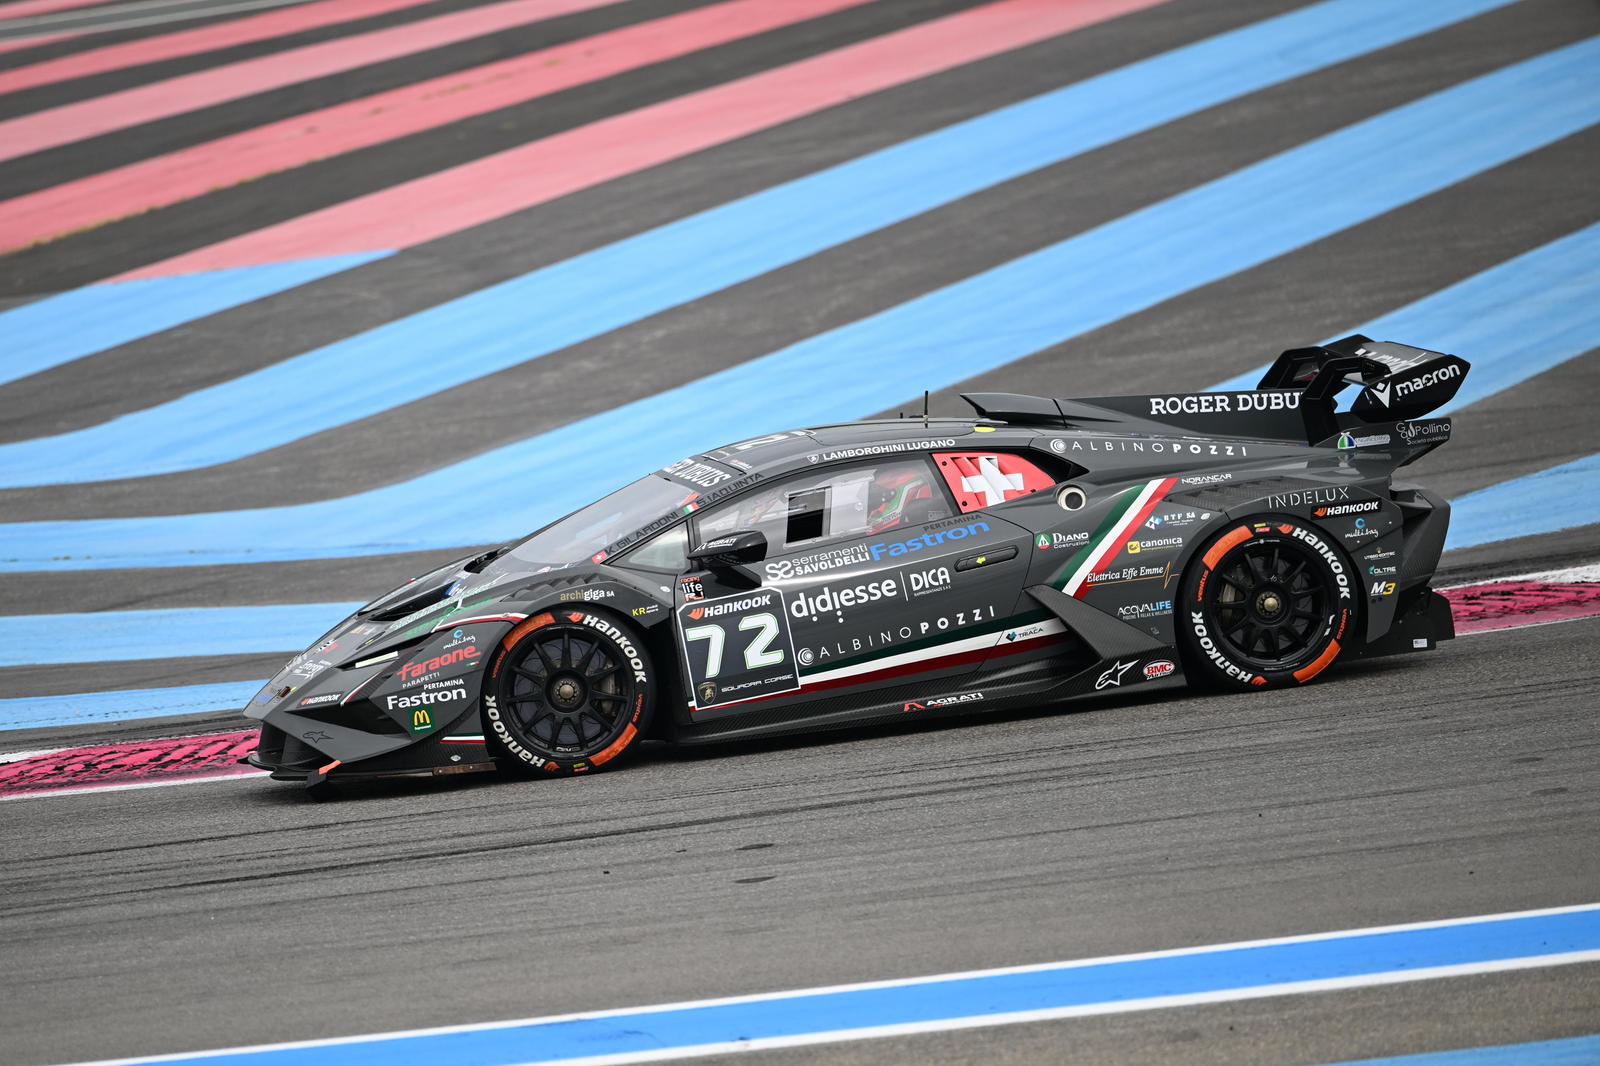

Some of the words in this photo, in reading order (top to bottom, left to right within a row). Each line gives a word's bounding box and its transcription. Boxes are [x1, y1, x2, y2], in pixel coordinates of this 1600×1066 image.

[1395, 364, 1460, 397] macron
[1150, 394, 1231, 415] ROGER
[1237, 391, 1303, 411] DUBU
[822, 443, 905, 461] LAMBORGHINI
[907, 439, 956, 450] LUGANO
[1181, 473, 1232, 484] NORANCAR
[1268, 486, 1349, 508] INDELUX
[922, 513, 983, 532] PERTAMINA
[869, 521, 991, 561] Fastron
[1141, 537, 1183, 548] canonica
[792, 543, 868, 566] serramenti
[795, 552, 870, 576] SAVOLDELLI
[1087, 571, 1120, 583] Elettrica
[1122, 568, 1138, 580] Effe
[1140, 566, 1164, 576] Emme
[560, 589, 605, 601] archigiga
[682, 582, 703, 593] life
[790, 579, 897, 623] didiesse
[909, 566, 951, 591] DICA
[1370, 581, 1396, 595] M3
[632, 607, 646, 616] KR
[685, 612, 785, 679] 72
[397, 645, 481, 681] faraone
[1147, 664, 1171, 675] BMC
[402, 672, 440, 689] PARAPETTI
[423, 678, 465, 690] PERTAMINA
[721, 680, 762, 693] SQUADRA
[764, 674, 794, 684] CORSE
[386, 687, 467, 710] Fastron
[927, 692, 984, 706] AGRATI
